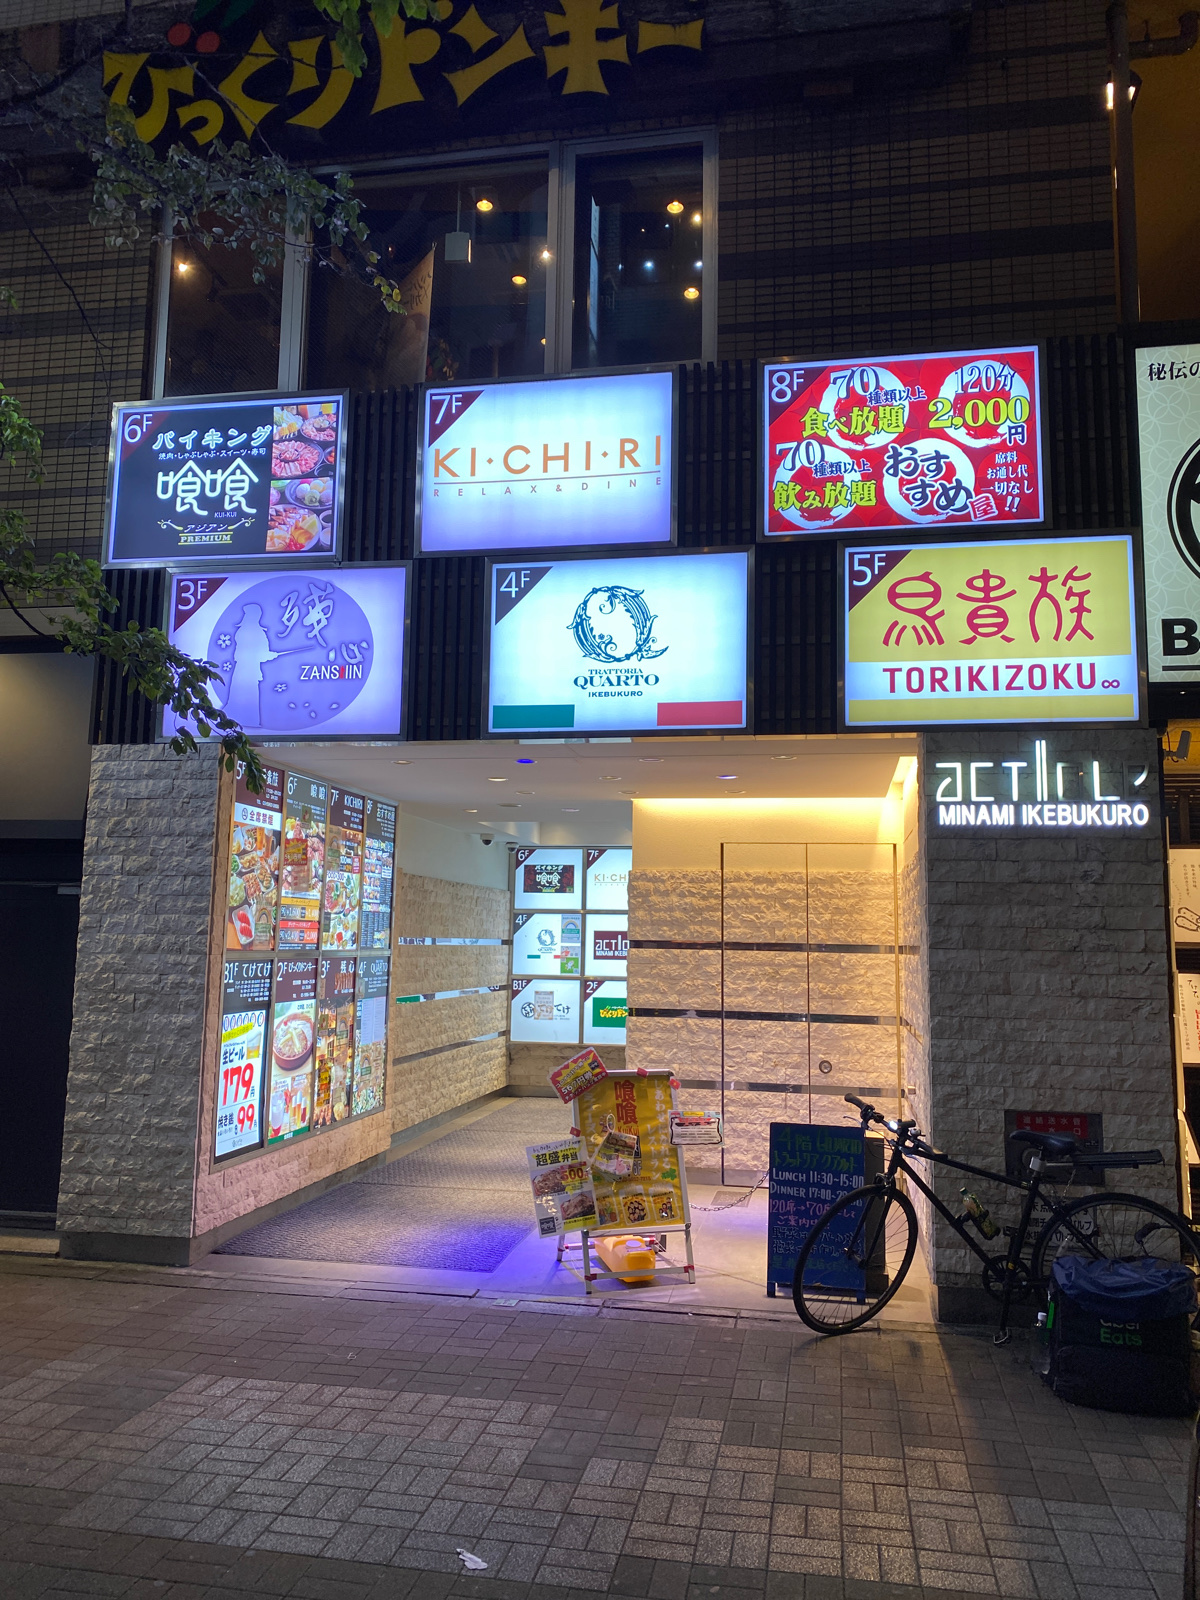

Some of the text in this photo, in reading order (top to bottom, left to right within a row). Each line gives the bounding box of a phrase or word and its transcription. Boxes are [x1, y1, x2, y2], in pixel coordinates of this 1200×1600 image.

[771, 370, 804, 402] 8F
[954, 363, 1018, 395] 120分
[431, 393, 463, 424] 7F
[124, 413, 153, 443] 6F
[800, 403, 906, 438] 食べ放題
[152, 424, 273, 450] バイキング
[987, 465, 1029, 479] お通し代
[773, 480, 877, 512] 飲み放題
[981, 480, 1034, 497] 一切なし
[214, 511, 238, 519] KUI-KUI
[184, 523, 228, 533] アジアン
[180, 533, 232, 543] PREMIUM
[853, 553, 887, 586] 5F
[500, 570, 531, 598] 4F
[178, 580, 208, 610] 3F
[882, 565, 1096, 648] 鳥貴族
[573, 674, 660, 690] QUARTO
[882, 662, 1097, 694] TORIKIZOKU
[588, 690, 643, 698] IKEBUKURO
[236, 760, 247, 780] 5F
[287, 777, 298, 795] 6F
[331, 789, 339, 806] 7F
[939, 804, 1150, 827] MINAMI IKEBUKURO
[517, 850, 530, 861] 6F
[588, 850, 599, 861] 7F
[515, 914, 528, 926] 4F
[242, 961, 272, 978] てけてけ
[276, 962, 288, 981] 2F
[321, 960, 331, 978] 3F
[358, 961, 367, 978] 4F
[512, 980, 527, 990] B1F
[586, 981, 598, 993] 2F
[222, 1062, 254, 1107] 179
[236, 1103, 255, 1134] 99
[536, 1151, 579, 1167] 超盛弁当
[647, 1124, 661, 1181] レストラン
[773, 1167, 806, 1183] LUNCH
[770, 1181, 806, 1199] DINNER
[1100, 1328, 1143, 1346] Eats
